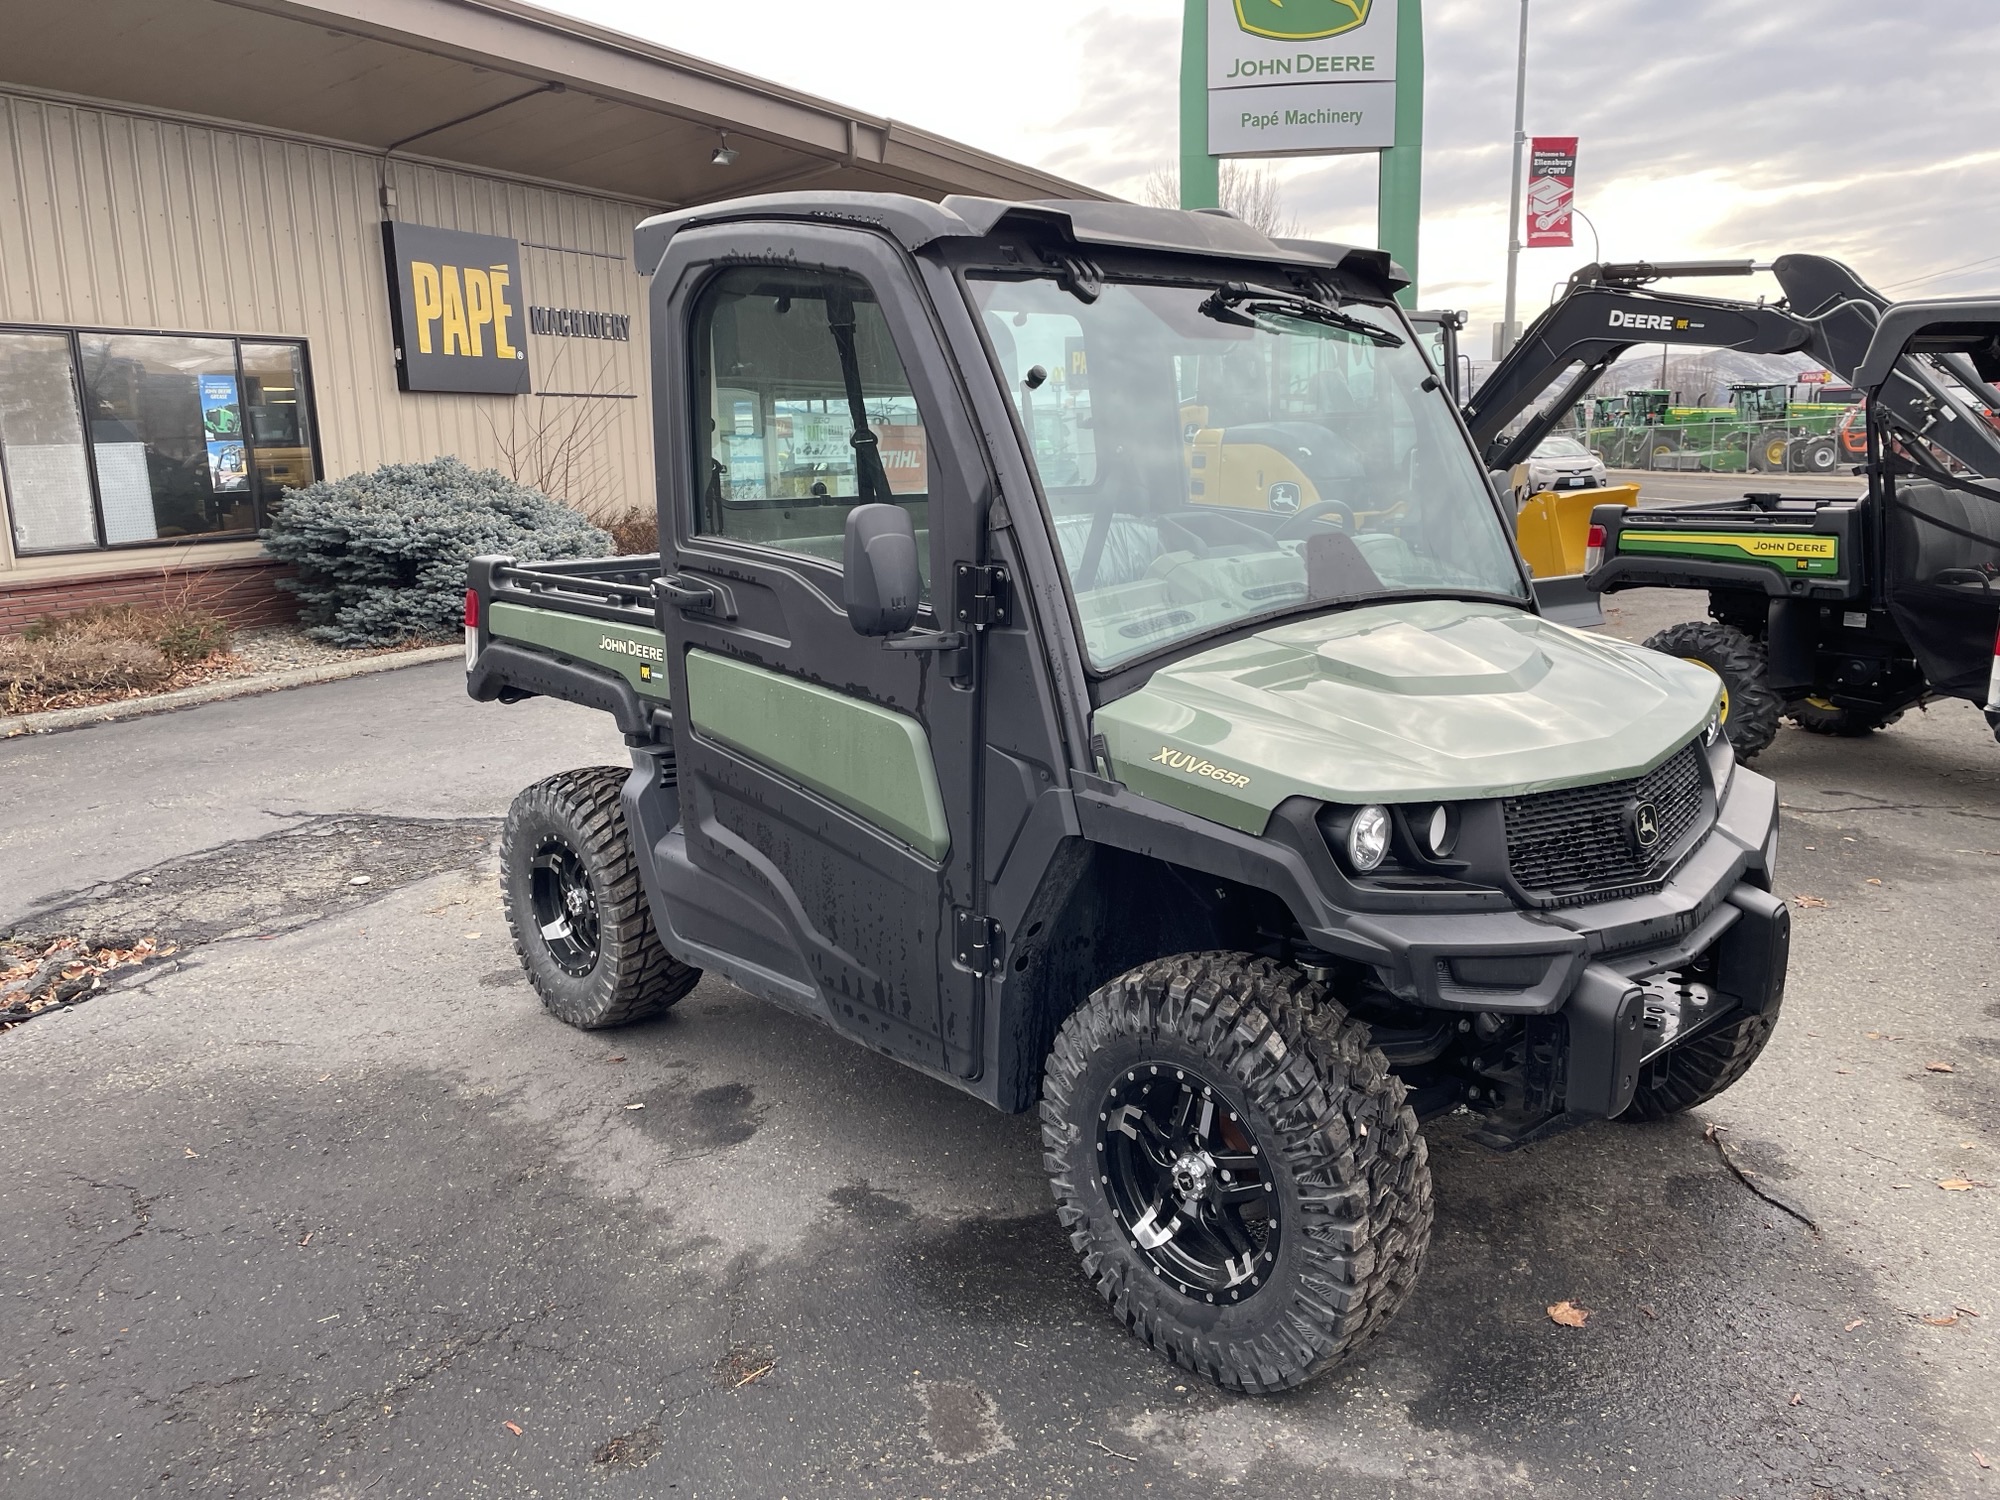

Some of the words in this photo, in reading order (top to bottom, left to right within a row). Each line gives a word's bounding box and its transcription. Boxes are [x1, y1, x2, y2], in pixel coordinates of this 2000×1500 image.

[1227, 58, 1291, 78] JOHN
[1297, 54, 1375, 73] DEERE
[1241, 111, 1279, 130] Papé
[1285, 109, 1363, 126] Machinery
[1534, 159, 1572, 167] Ellensburg
[530, 306, 631, 342] MACHINERY
[1609, 310, 1674, 330] DEERE
[880, 450, 920, 468] STIHL
[1754, 541, 1785, 551] JOHN
[1787, 542, 1827, 552] DEERE
[599, 635, 627, 653] JOHN
[628, 640, 664, 661] DEERE
[1151, 746, 1251, 789] XUV865R
